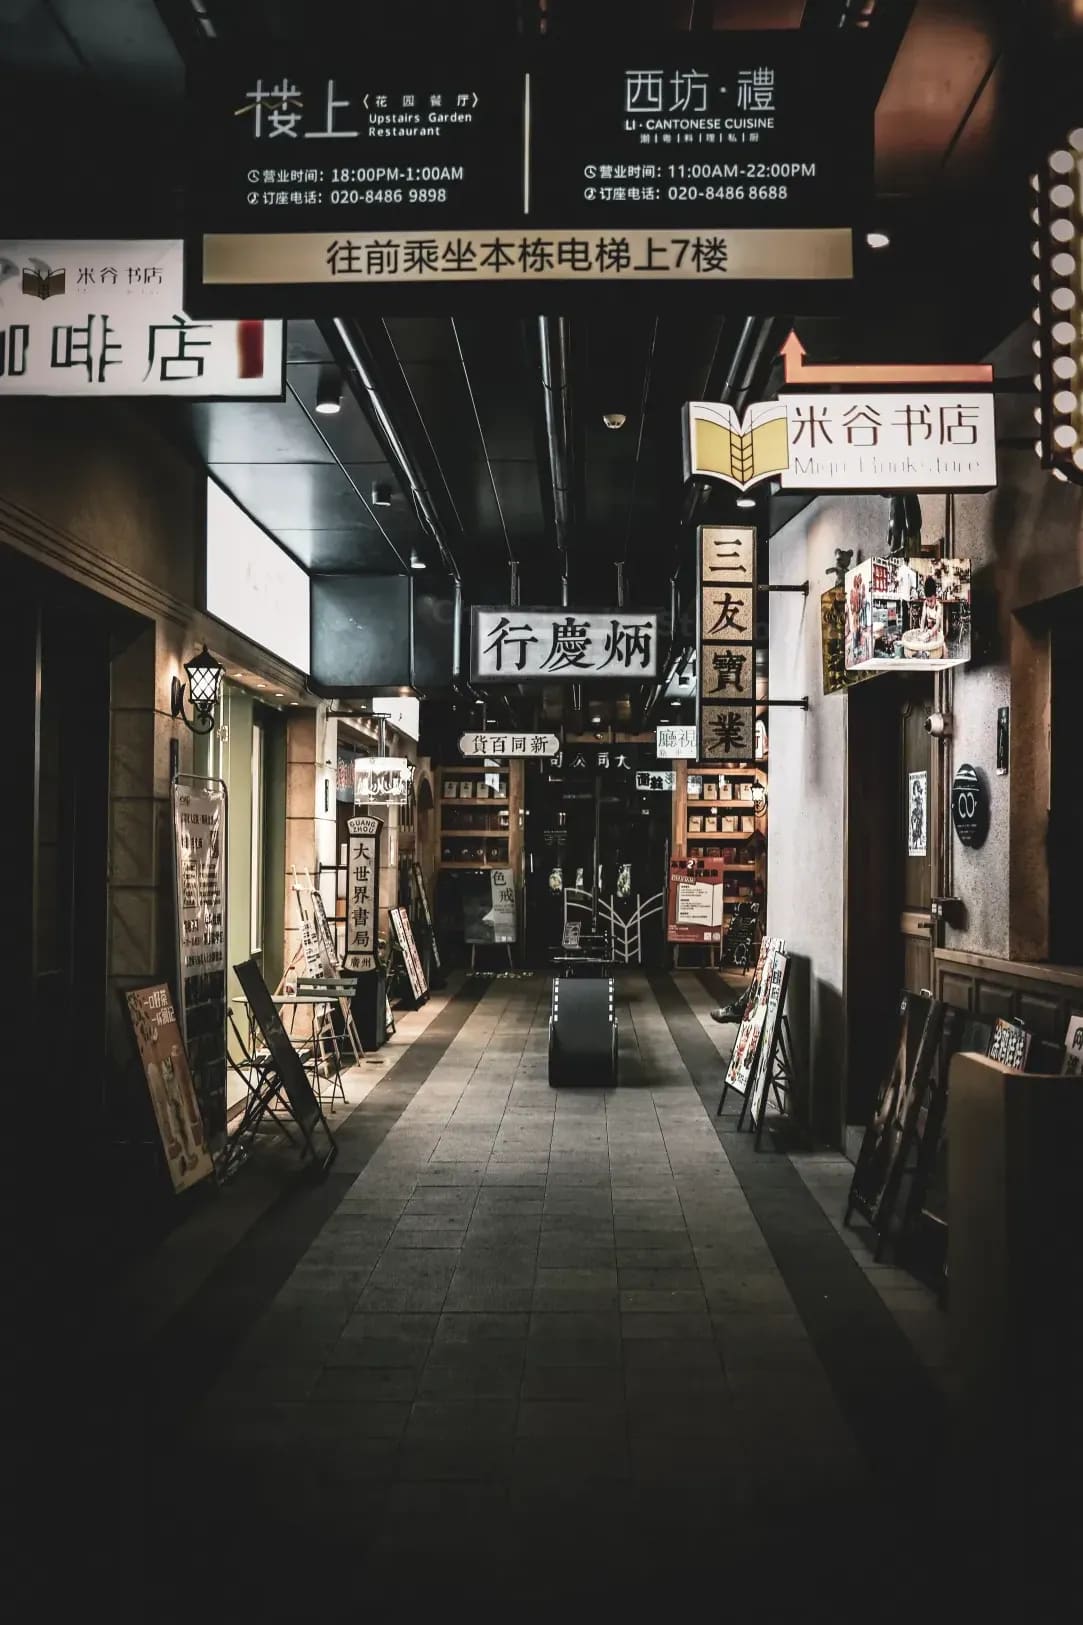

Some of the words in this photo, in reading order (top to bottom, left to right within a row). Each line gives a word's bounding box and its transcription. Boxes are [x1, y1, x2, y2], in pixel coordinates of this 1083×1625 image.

[235, 79, 358, 138] 楼上
[370, 113, 420, 125] Upstairs
[429, 112, 472, 123] Garden
[645, 119, 721, 130] CANTONESE
[725, 118, 775, 129] CUISINE
[369, 127, 440, 136] Restaurant
[331, 166, 464, 182] 18:00PM-1:00AM
[668, 163, 816, 178] 11:00AM-22:00PM
[331, 189, 402, 203] 020-8486
[408, 188, 447, 202] 9898
[668, 186, 744, 200] 020-8486
[748, 185, 788, 199] 8688
[327, 240, 728, 275] 往前乘坐本栋电梯上7楼
[791, 404, 980, 448] 米谷书店
[349, 819, 377, 829] GUANG
[352, 826, 375, 834] ZHOU
[352, 843, 371, 948] 大世界書局
